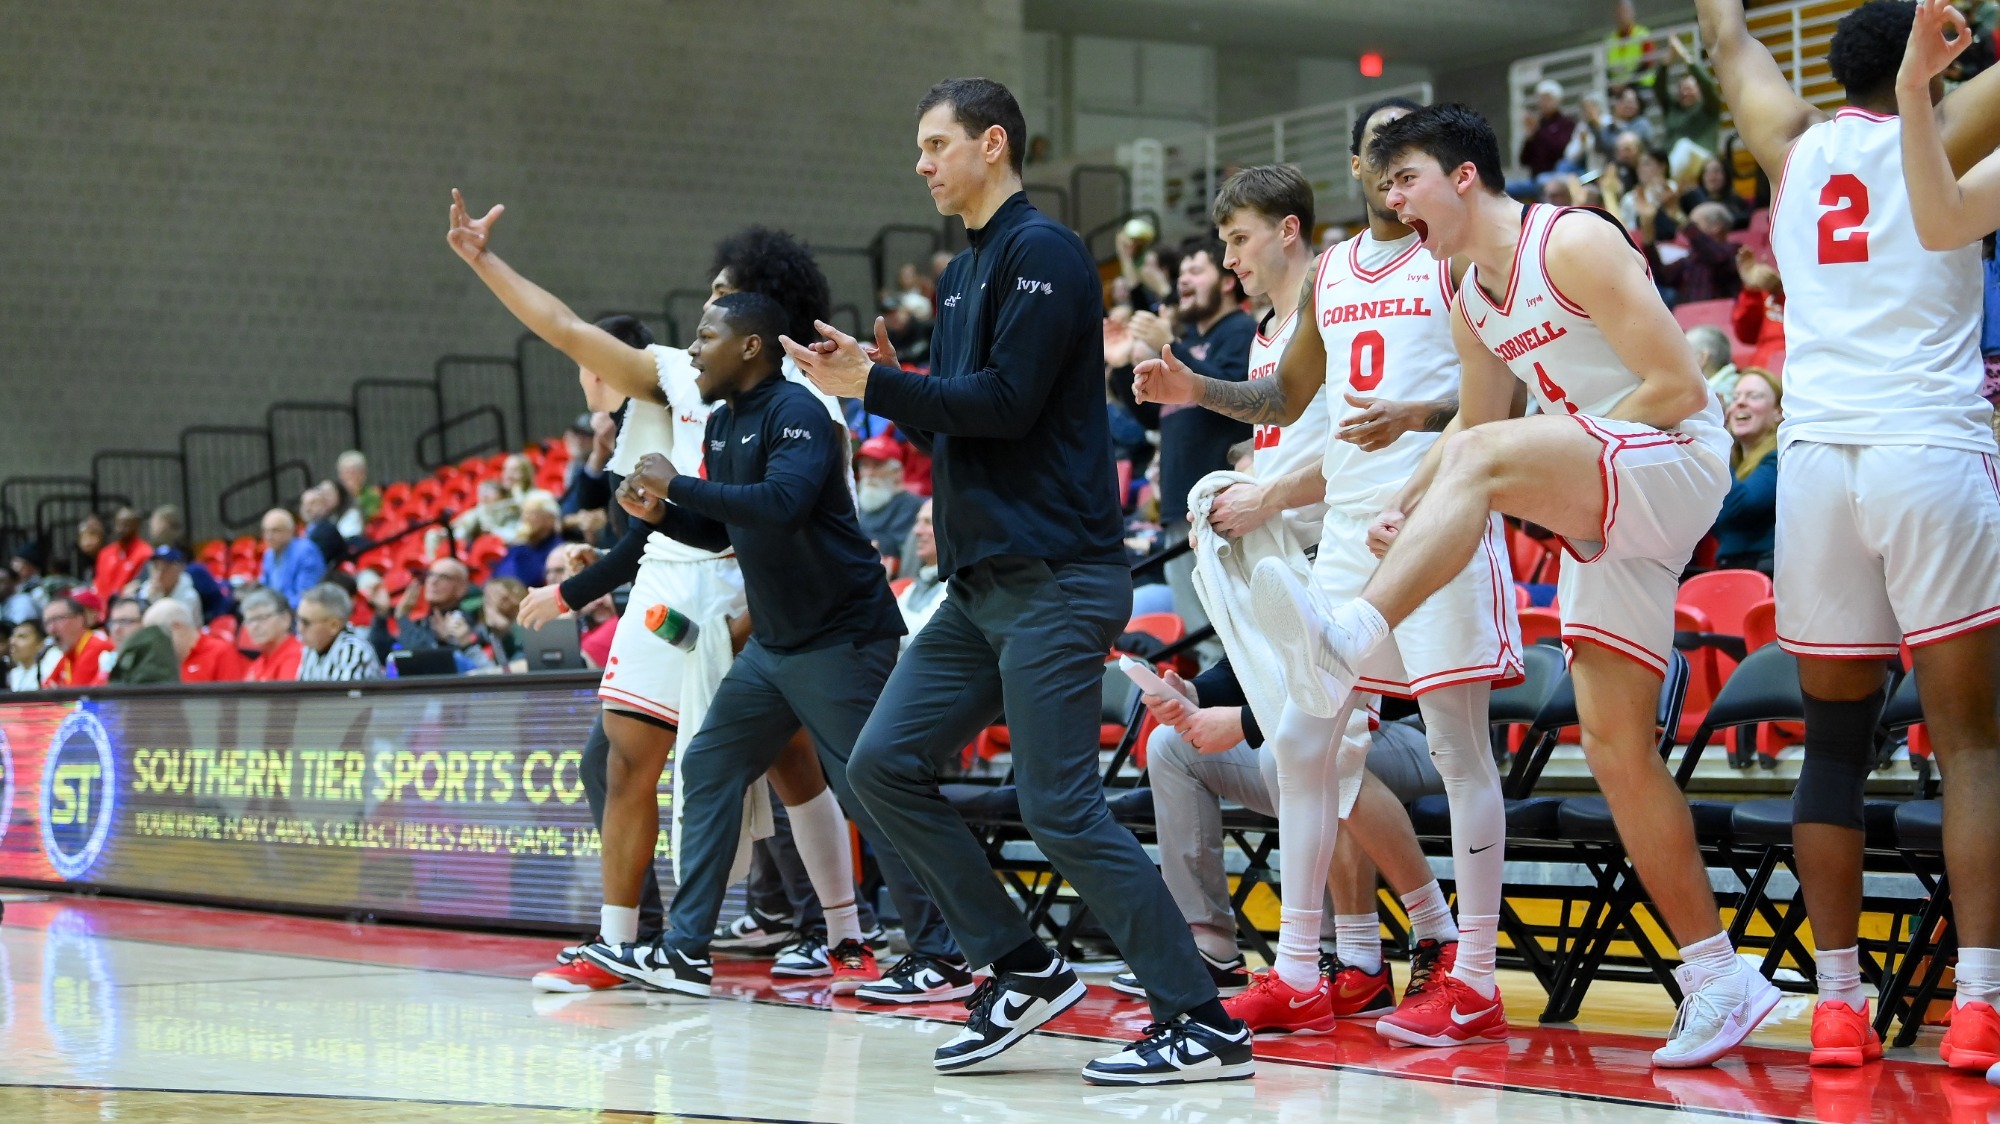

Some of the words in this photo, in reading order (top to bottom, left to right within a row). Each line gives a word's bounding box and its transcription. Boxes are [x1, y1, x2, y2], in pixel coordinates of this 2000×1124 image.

[1817, 174, 1870, 265] 2
[1016, 277, 1041, 294] Ivy
[1322, 297, 1432, 328] CORNELL
[1348, 329, 1385, 392] 0
[1494, 320, 1568, 364] CORNELL
[1532, 361, 1580, 415] 4
[782, 426, 803, 440] Ivy
[51, 763, 102, 825] ST
[132, 748, 293, 799] SOUTHERN
[300, 749, 366, 801] TIER
[372, 750, 515, 805] SPORTS
[321, 819, 456, 852] COLLECTIBLES
[458, 822, 502, 853] AND
[505, 824, 568, 856] GAME
[572, 826, 602, 857] DA
